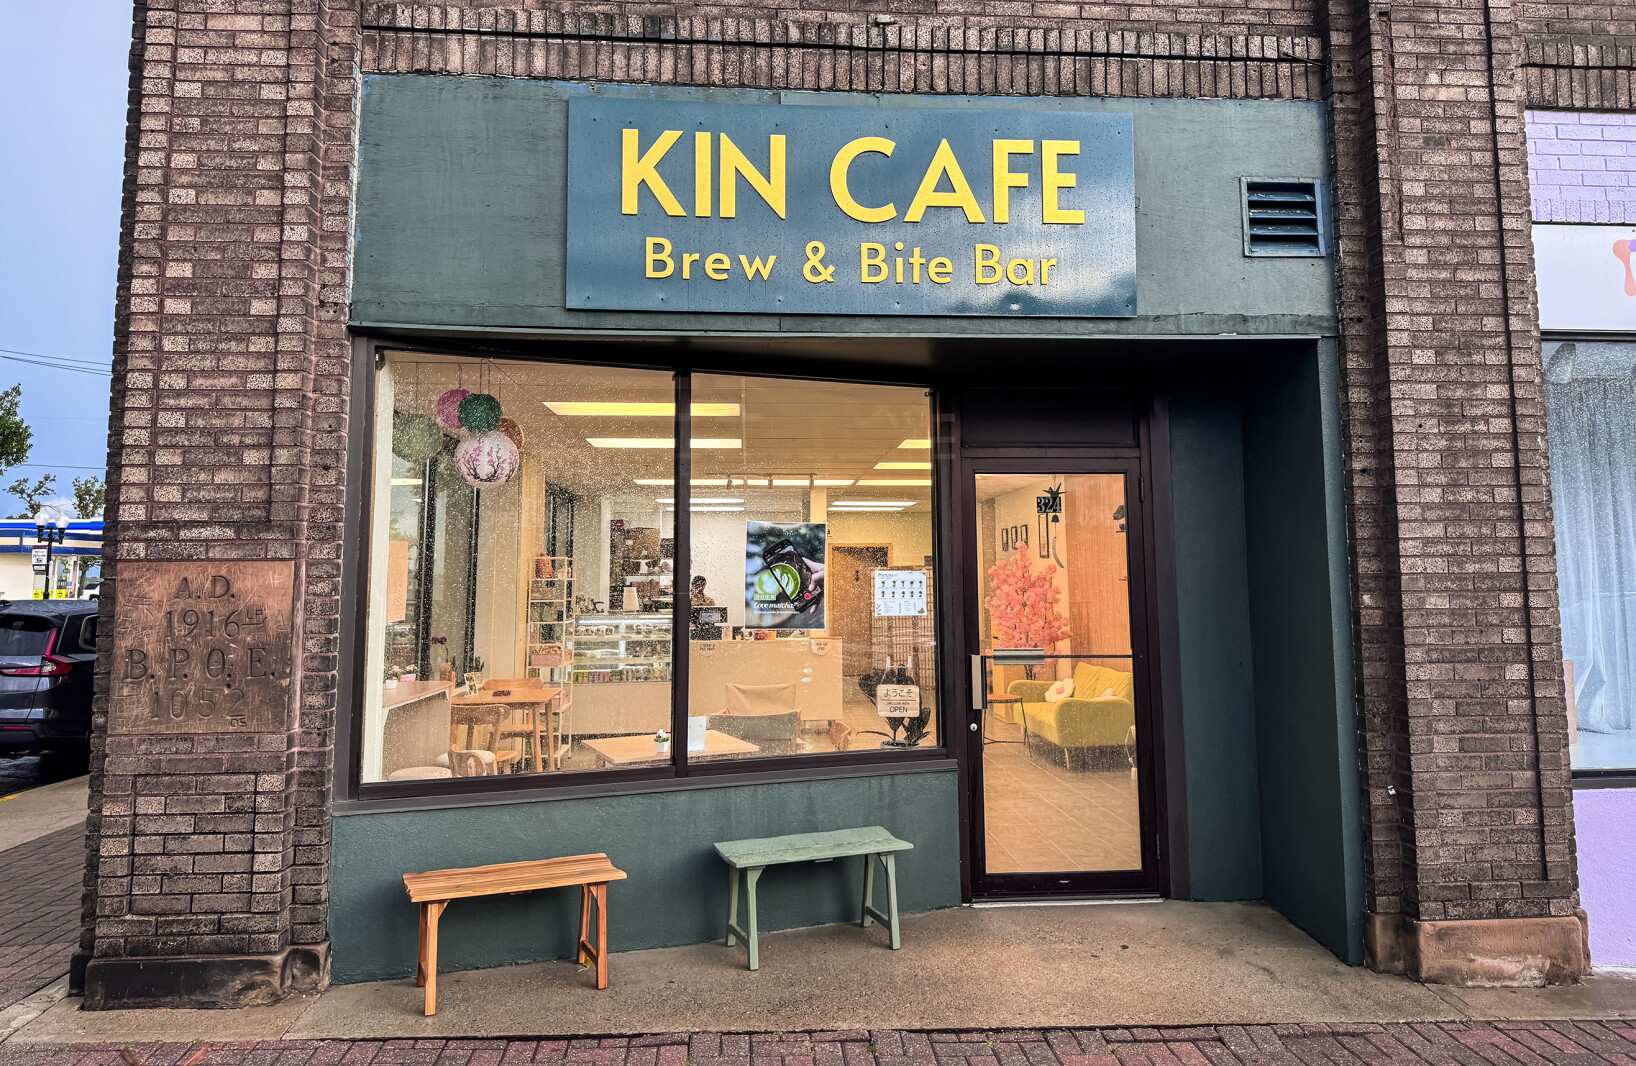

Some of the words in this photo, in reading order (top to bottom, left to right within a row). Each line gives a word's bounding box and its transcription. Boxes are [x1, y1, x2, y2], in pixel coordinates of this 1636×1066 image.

[621, 128, 786, 219] KIN
[829, 136, 1086, 224] CAFE
[644, 236, 777, 282] Brew
[803, 240, 835, 283] &
[860, 241, 953, 284] Bite
[974, 243, 1057, 285] Bar
[1037, 497, 1061, 512] 324
[174, 575, 236, 600] A.D.
[164, 609, 241, 639] 1916
[150, 688, 245, 719] 1052
[884, 688, 913, 697] ようこそ
